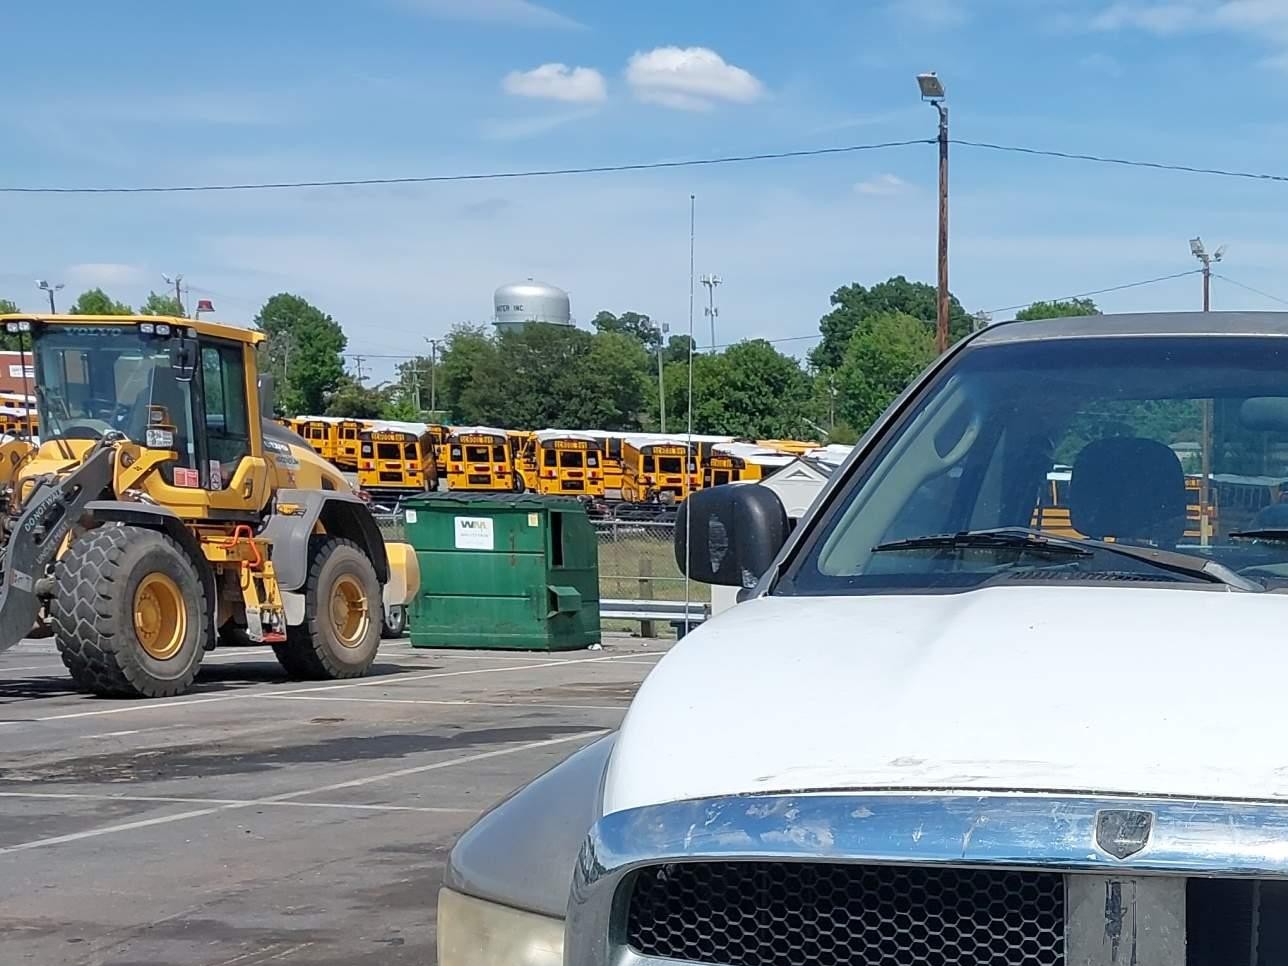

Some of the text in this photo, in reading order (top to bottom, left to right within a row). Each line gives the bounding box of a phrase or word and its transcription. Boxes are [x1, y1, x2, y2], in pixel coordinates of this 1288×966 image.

[64, 327, 121, 336] VOLVO
[24, 517, 36, 532] DO
[35, 501, 48, 520] NOT
